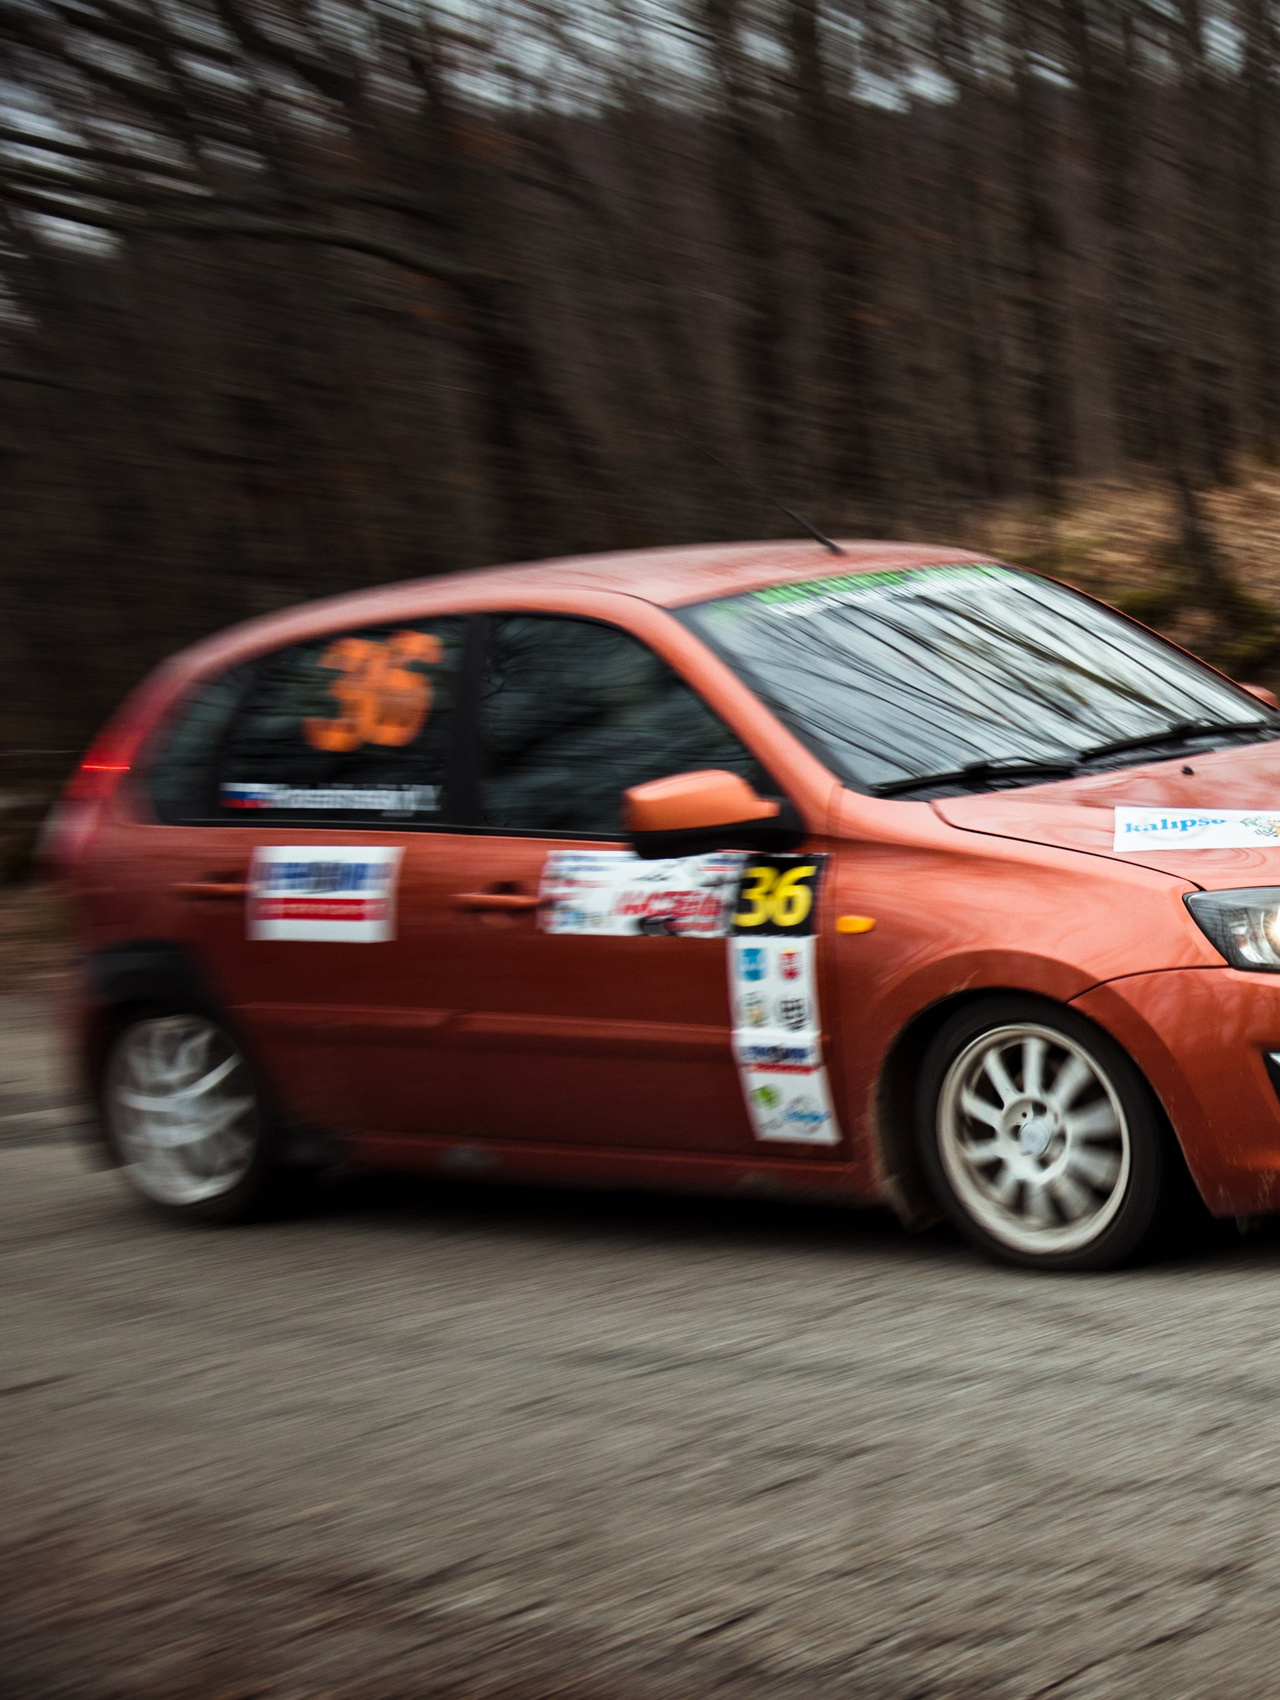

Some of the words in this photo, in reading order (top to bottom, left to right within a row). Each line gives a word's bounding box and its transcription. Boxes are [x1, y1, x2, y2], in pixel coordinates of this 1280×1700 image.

[302, 629, 445, 752] 36
[1124, 817, 1228, 834] kalipso
[731, 864, 818, 928] 36
